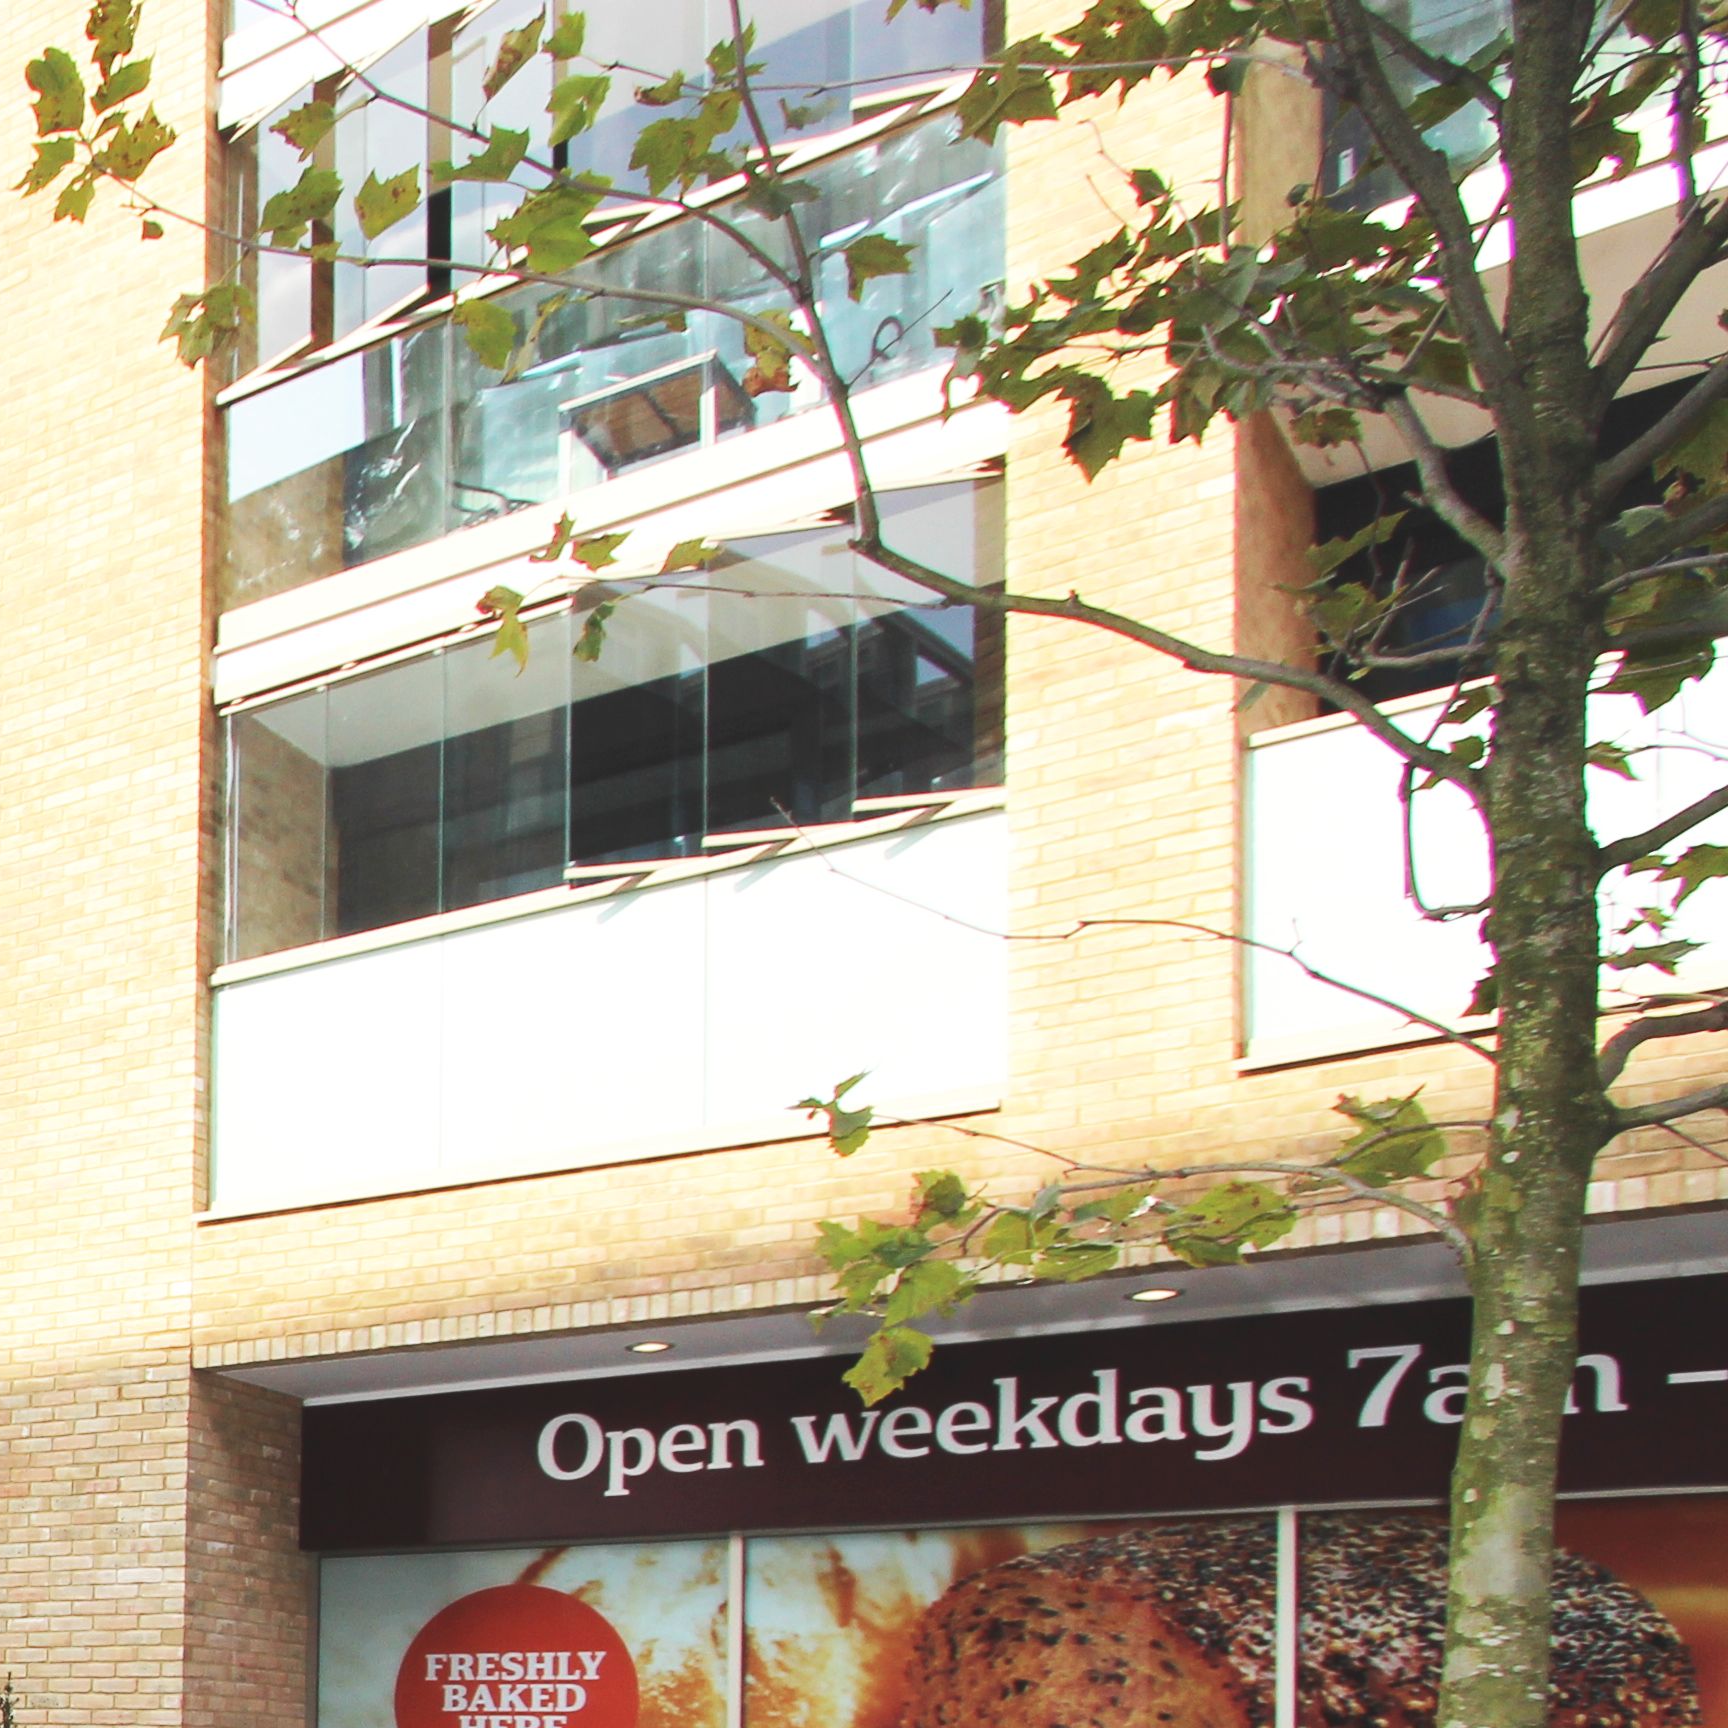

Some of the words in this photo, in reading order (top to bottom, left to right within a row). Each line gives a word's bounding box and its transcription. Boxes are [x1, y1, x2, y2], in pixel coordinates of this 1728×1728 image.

[536, 1412, 765, 1497] Open
[790, 1368, 1313, 1463] weekdays
[424, 1651, 607, 1681] FRESHLY
[442, 1684, 587, 1712] BAKED
